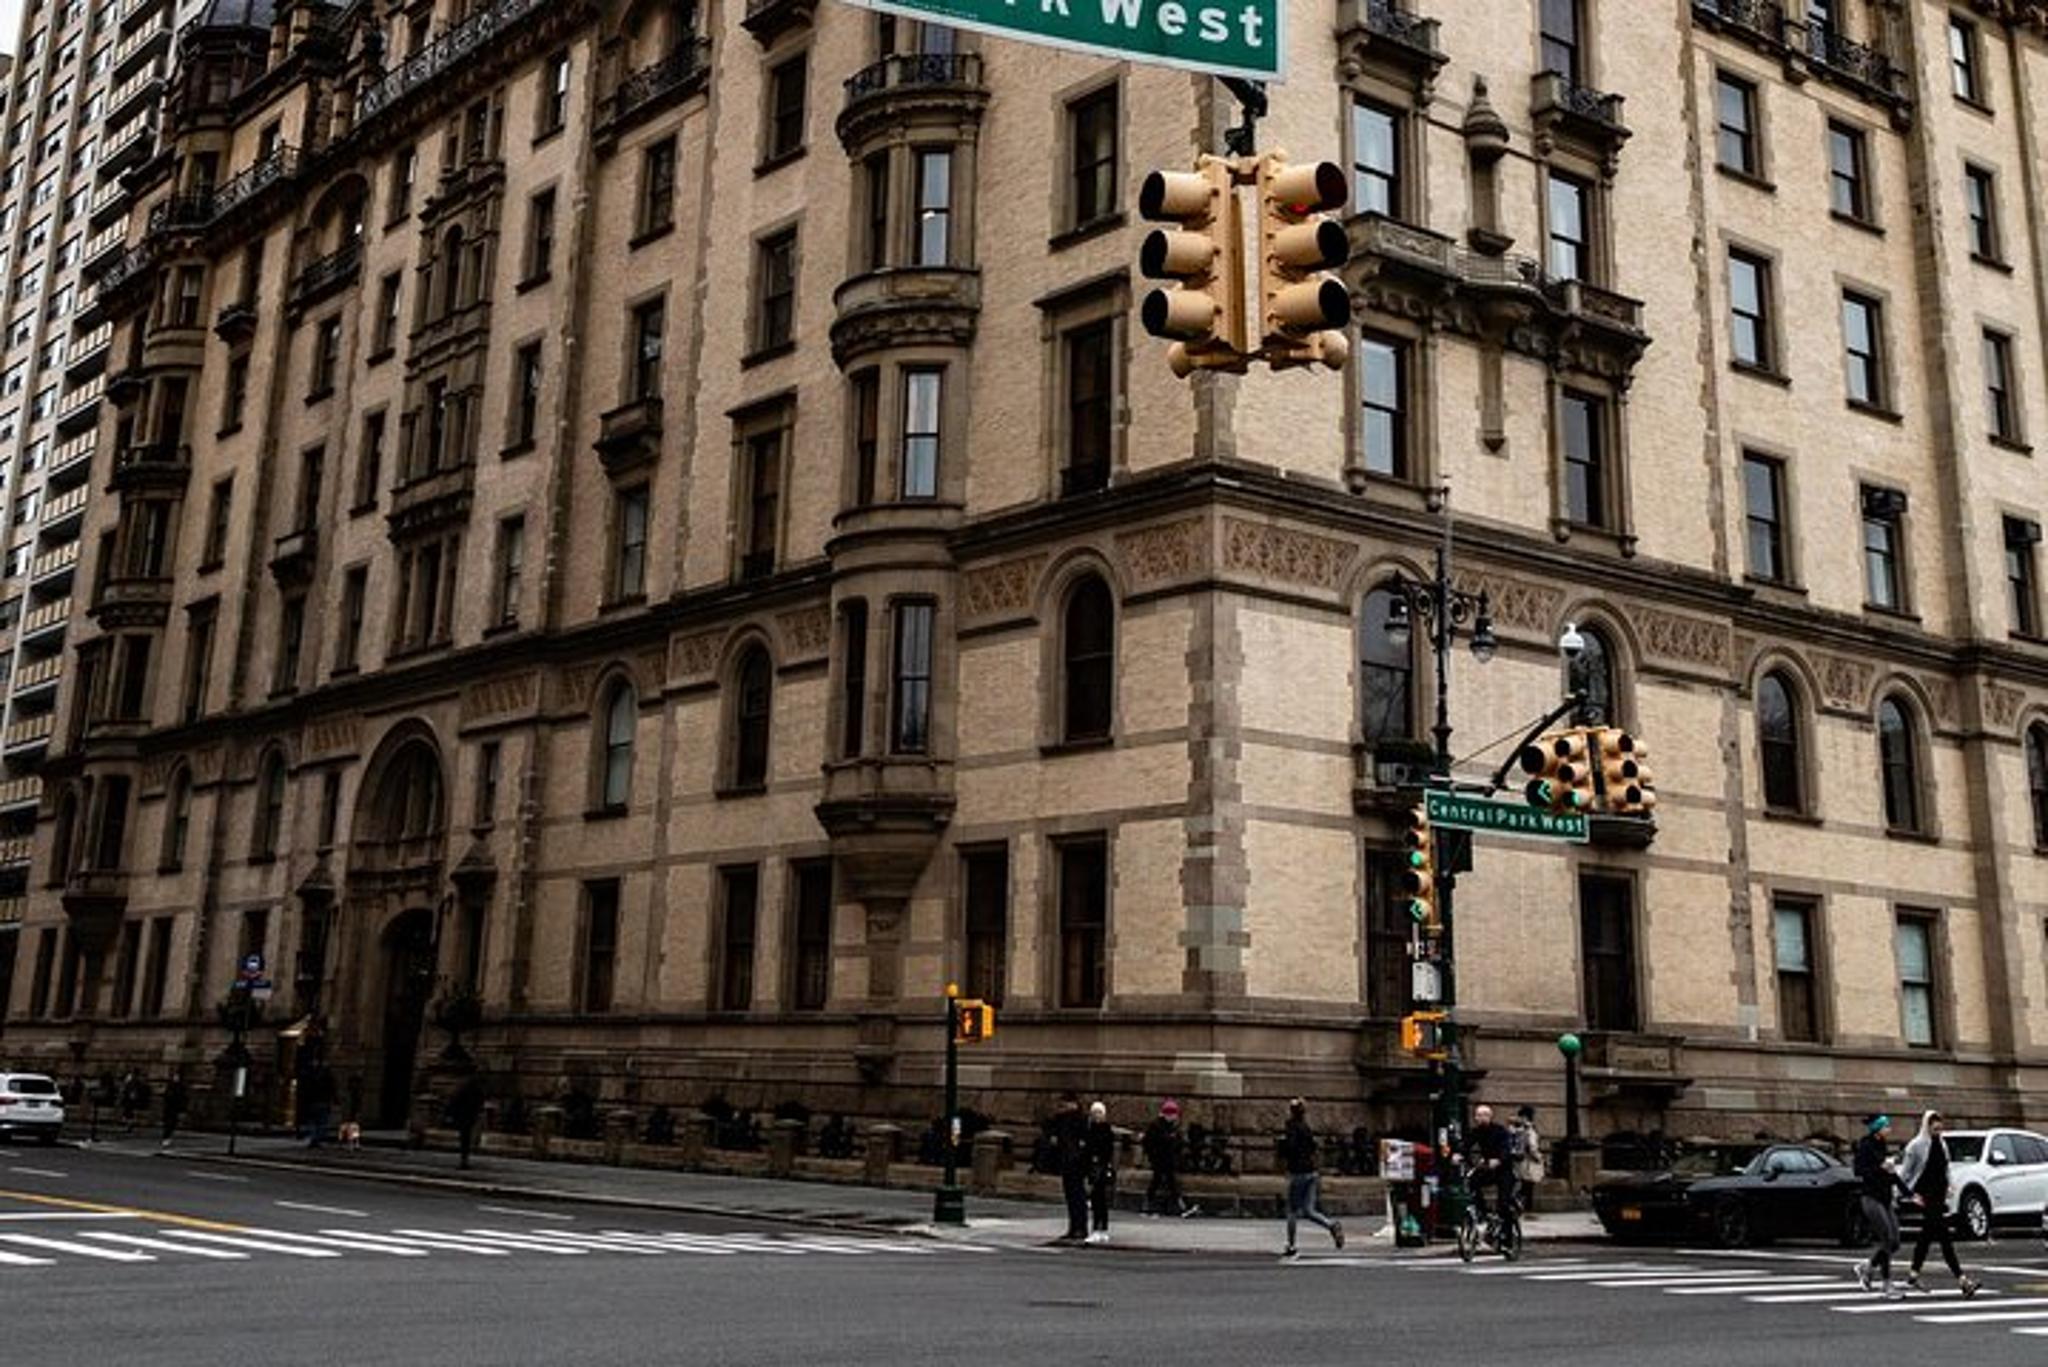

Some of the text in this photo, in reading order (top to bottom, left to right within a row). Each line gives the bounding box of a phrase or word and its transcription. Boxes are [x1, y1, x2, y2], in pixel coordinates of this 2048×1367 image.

[1101, 0, 1263, 47] West
[1429, 799, 1583, 833] Central Park West
